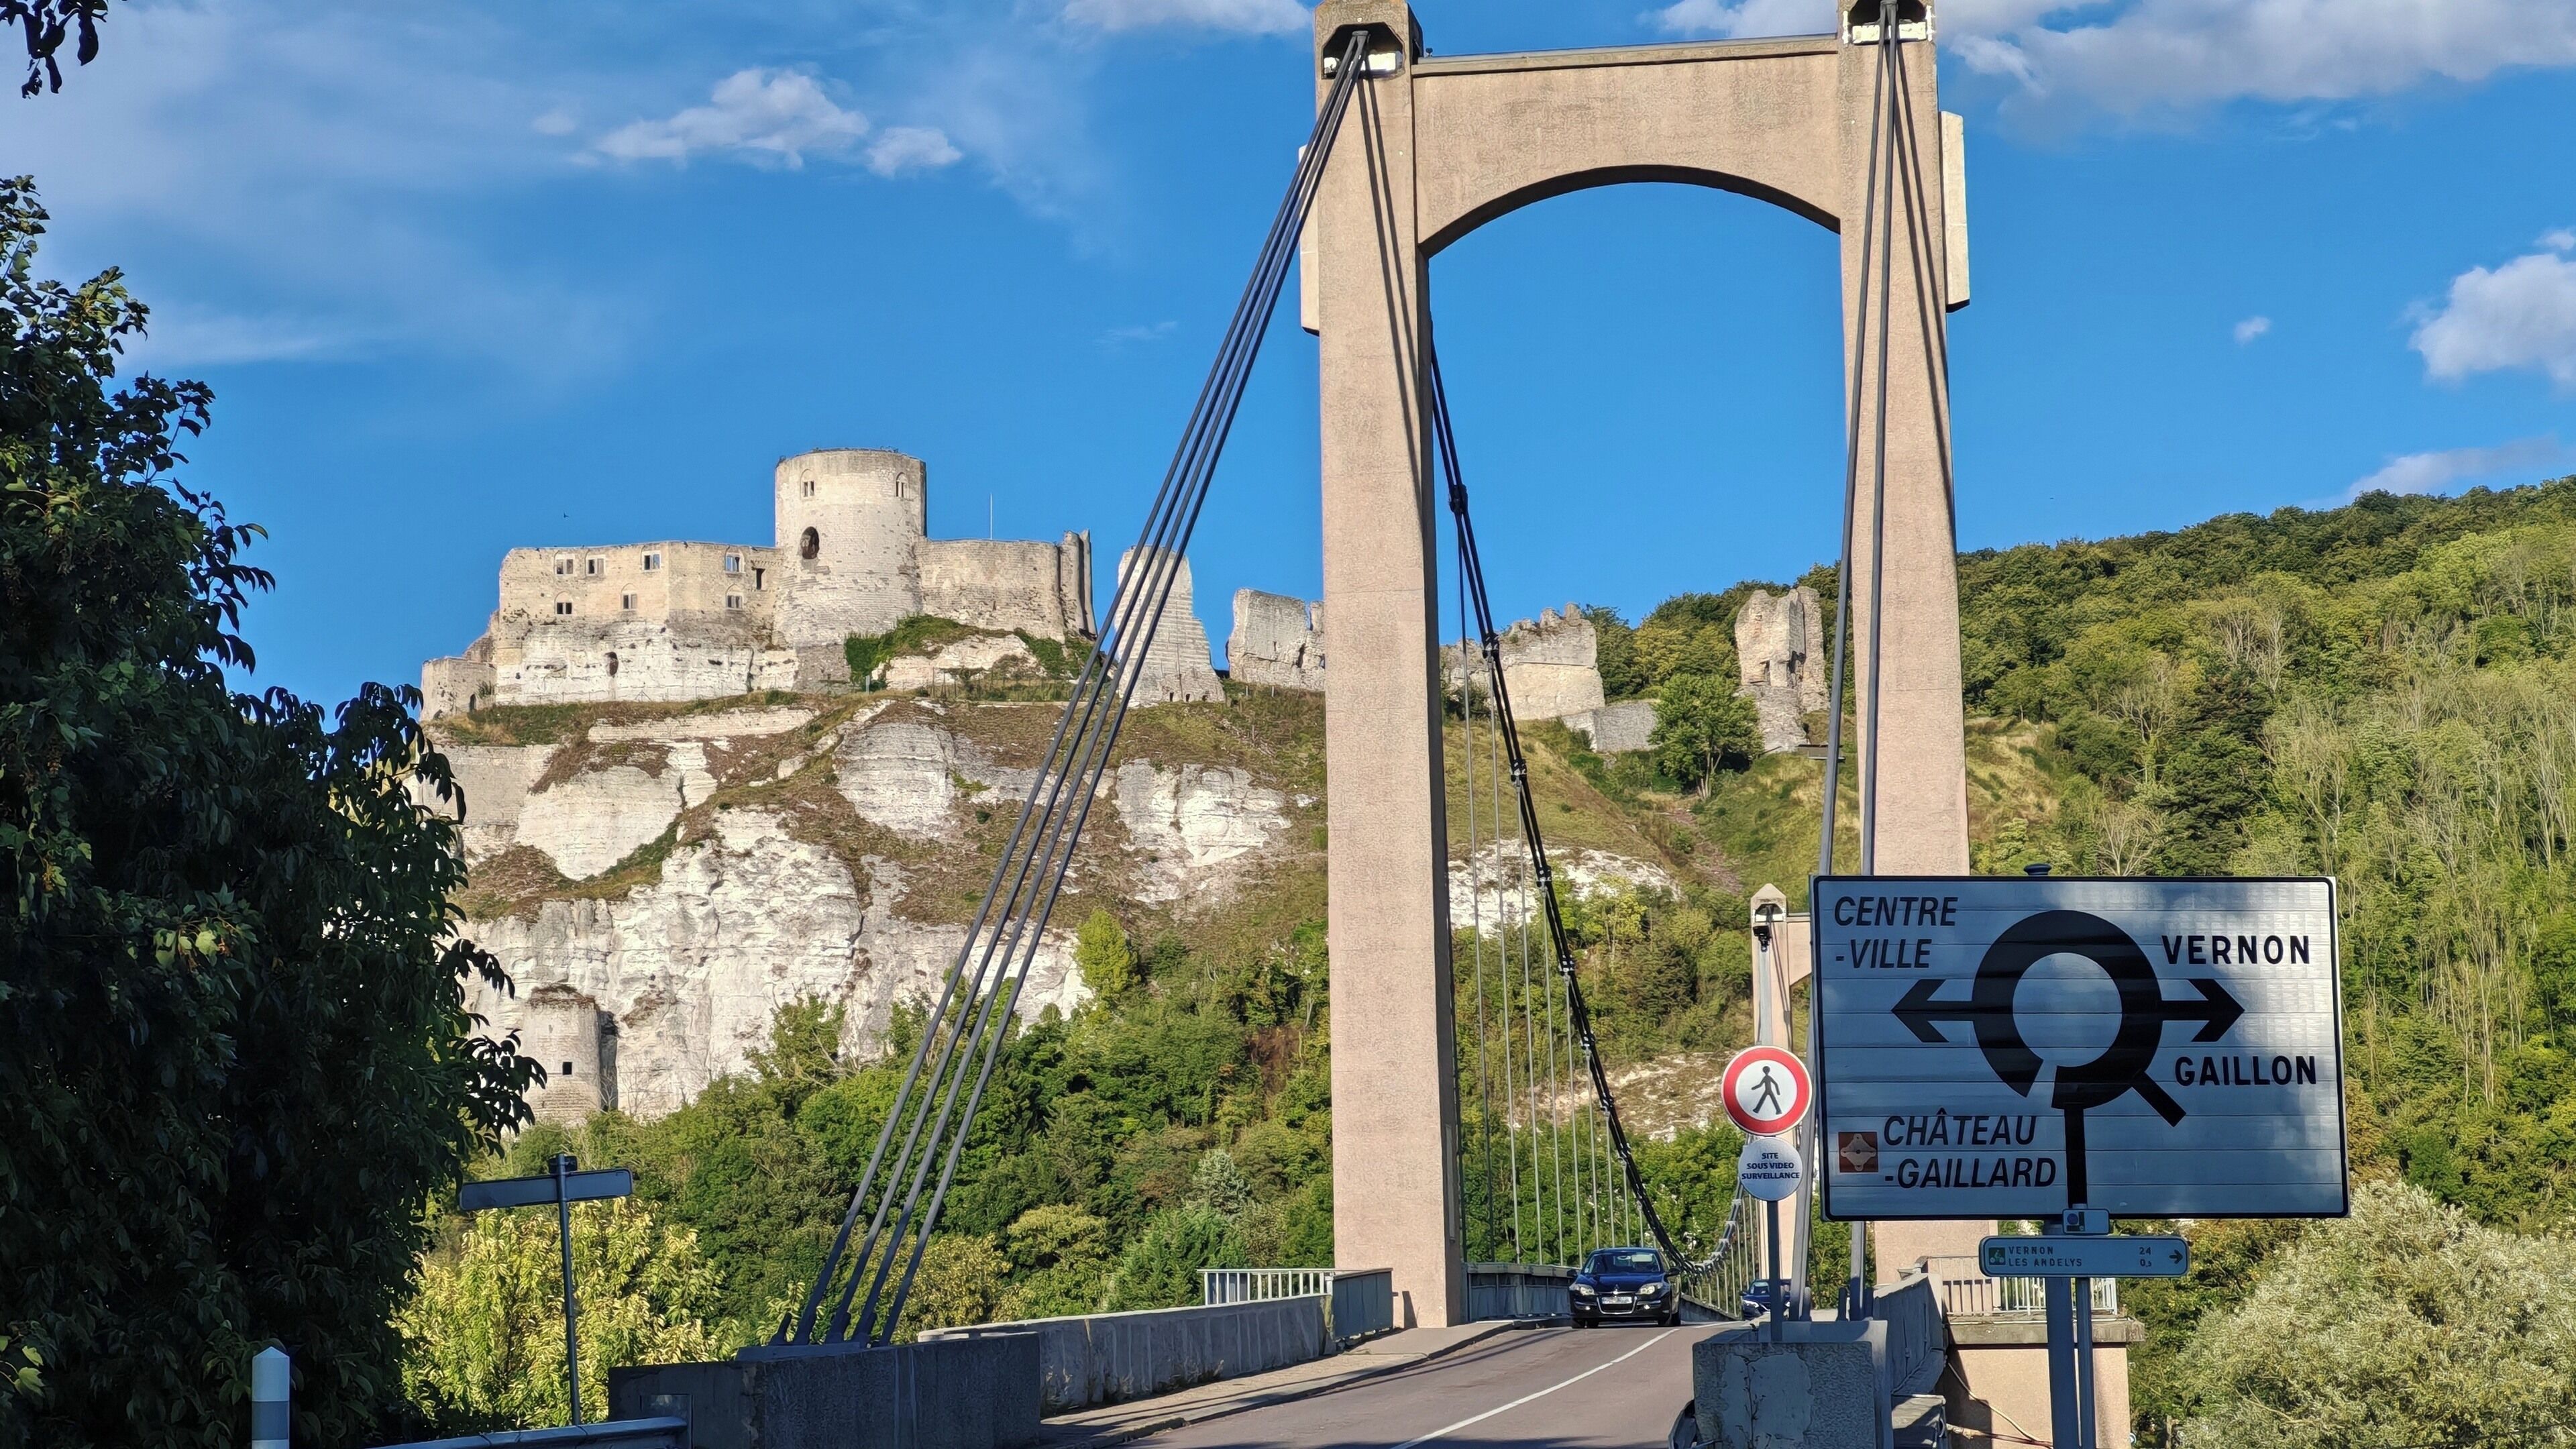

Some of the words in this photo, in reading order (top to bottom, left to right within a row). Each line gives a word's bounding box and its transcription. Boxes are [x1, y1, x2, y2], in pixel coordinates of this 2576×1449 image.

[1835, 896, 1957, 926] CENTRE
[1835, 938, 1931, 968] -VILLE
[2162, 935, 2310, 964] VERNON
[2175, 1056, 2316, 1086] GAILLON
[1884, 1108, 2036, 1145] CHÂTEAU
[1884, 1158, 2055, 1188] -GAILLARD
[2008, 1246, 2053, 1254] VERNON
[2139, 1247, 2151, 1255] 24
[2008, 1258, 2028, 1267] LES
[2034, 1258, 2082, 1267] ANDELYS
